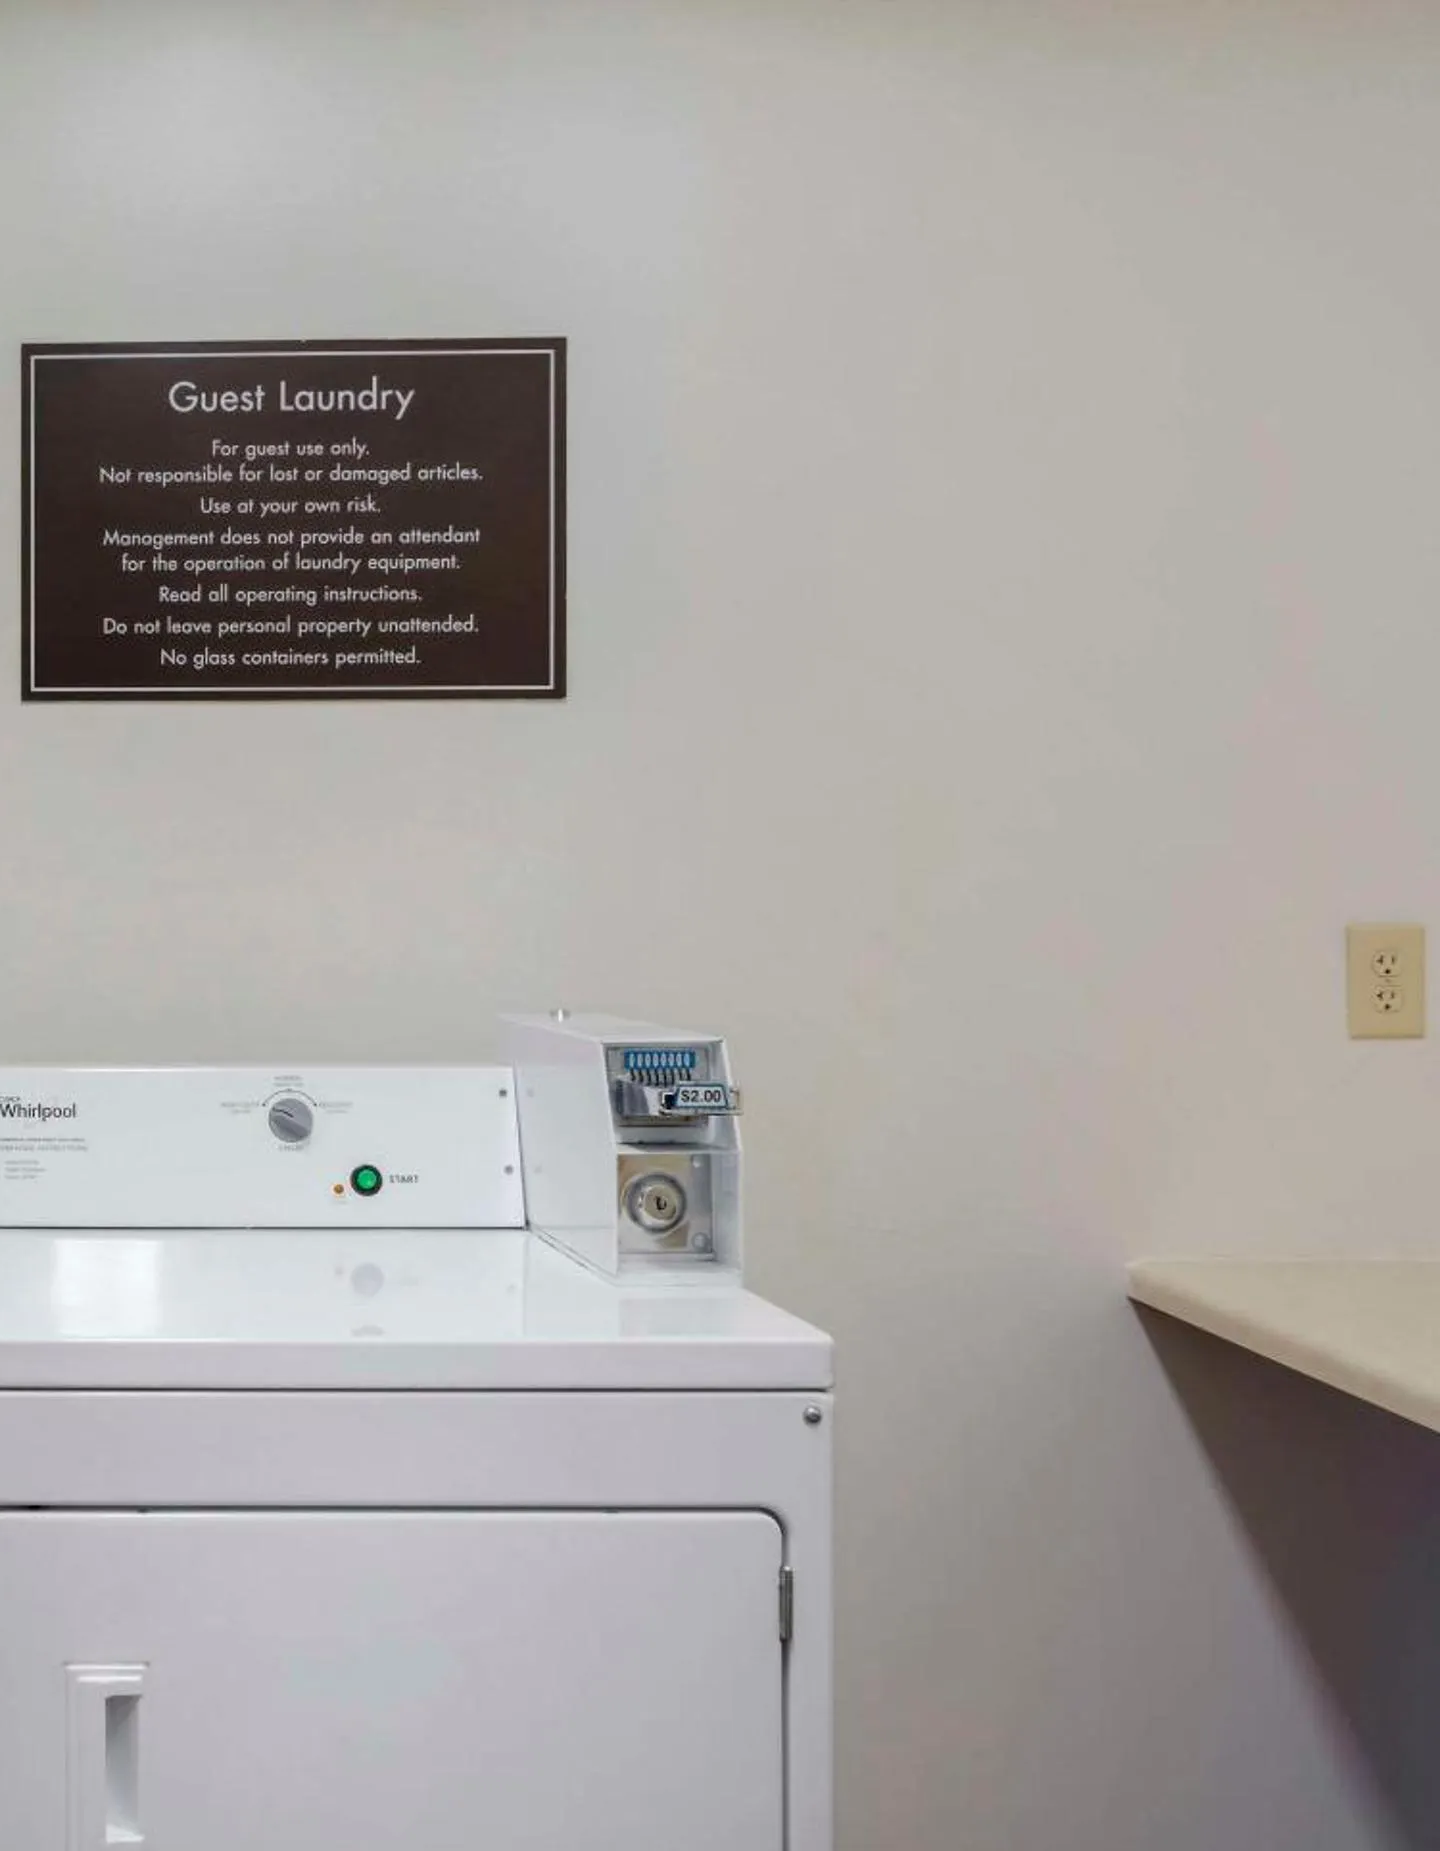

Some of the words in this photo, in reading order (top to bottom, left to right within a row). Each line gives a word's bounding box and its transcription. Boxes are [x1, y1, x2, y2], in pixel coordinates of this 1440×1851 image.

[169, 381, 265, 412] Guest
[280, 376, 414, 420] Laundry
[212, 440, 239, 456] For
[245, 441, 290, 461] guest
[297, 445, 323, 455] use
[330, 437, 369, 459] only.
[100, 467, 131, 483] Not
[138, 464, 232, 486] responsible
[240, 463, 263, 481] for
[270, 464, 298, 481] lost
[305, 470, 323, 481] or
[330, 462, 411, 485] damaged
[418, 462, 482, 480] articles.
[201, 497, 230, 513] Use
[237, 499, 254, 513] at
[260, 502, 298, 517] your
[305, 501, 340, 513] own
[347, 494, 380, 512] risk.
[103, 530, 214, 549] Management
[221, 527, 260, 544] does
[268, 530, 294, 544] not
[301, 526, 364, 548] provide
[371, 533, 392, 544] an
[399, 525, 480, 543] attendant
[122, 553, 145, 571] for
[153, 553, 177, 571] the
[184, 555, 265, 575] operation
[272, 552, 289, 570] of
[296, 552, 361, 574] laundry
[368, 554, 460, 574] equipment.
[160, 584, 201, 602] Read
[209, 584, 227, 601] all
[236, 586, 317, 606] operating
[325, 585, 421, 601] instructions.
[104, 618, 127, 634] Do
[134, 620, 160, 634] not
[168, 616, 211, 634] leave
[219, 615, 290, 637] personal
[298, 619, 371, 637] property
[378, 614, 478, 632] unattended.
[161, 649, 186, 665] No
[193, 647, 235, 669] glass
[242, 648, 328, 665] containers
[336, 646, 420, 668] permitted.
[0, 1102, 76, 1121] Whirlpool
[389, 1174, 419, 1184] START
